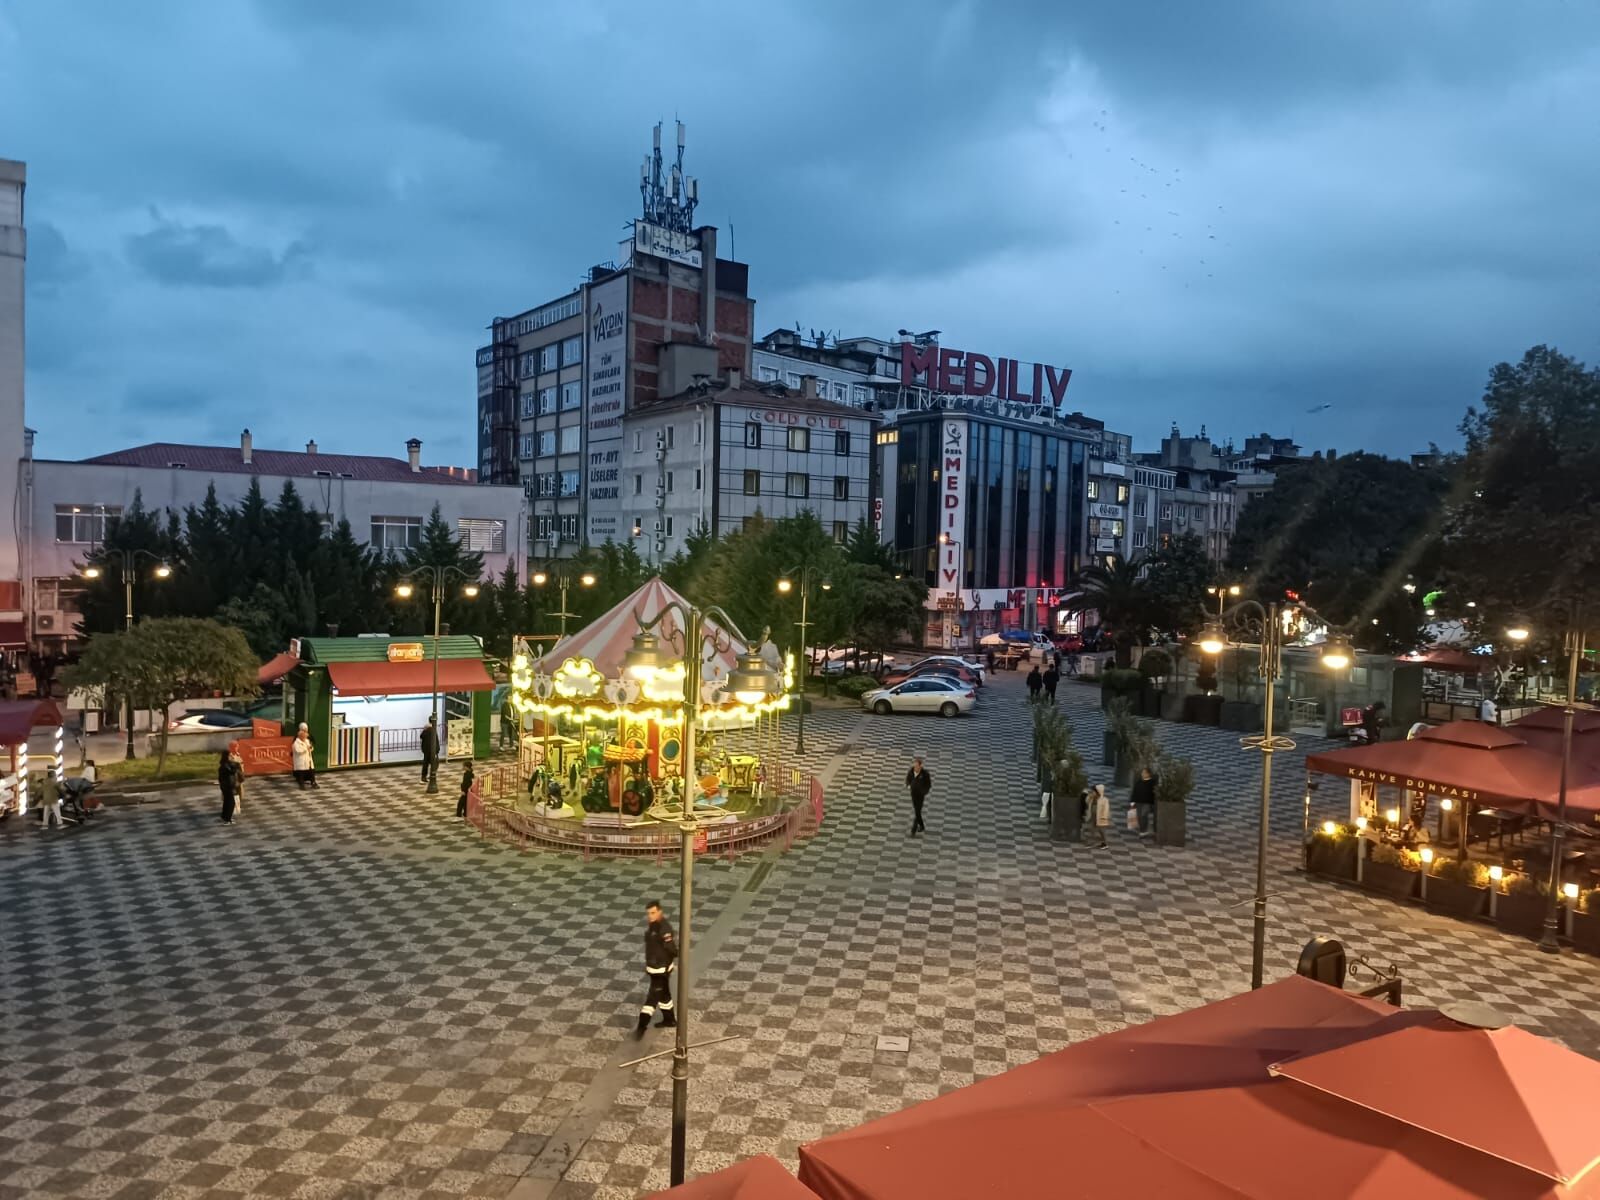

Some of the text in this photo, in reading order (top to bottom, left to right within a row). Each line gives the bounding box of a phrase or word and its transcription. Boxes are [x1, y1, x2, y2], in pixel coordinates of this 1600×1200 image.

[901, 342, 1073, 407] MEDILIV
[591, 452, 603, 464] TYT
[606, 450, 619, 464] AYT
[590, 468, 618, 482] LİSELERE
[590, 487, 619, 500] HAZIRLIK
[944, 457, 961, 583] MEDILIV
[1007, 589, 1063, 609] MEILIV
[1349, 768, 1478, 800] KAHVE DÜNYASI
